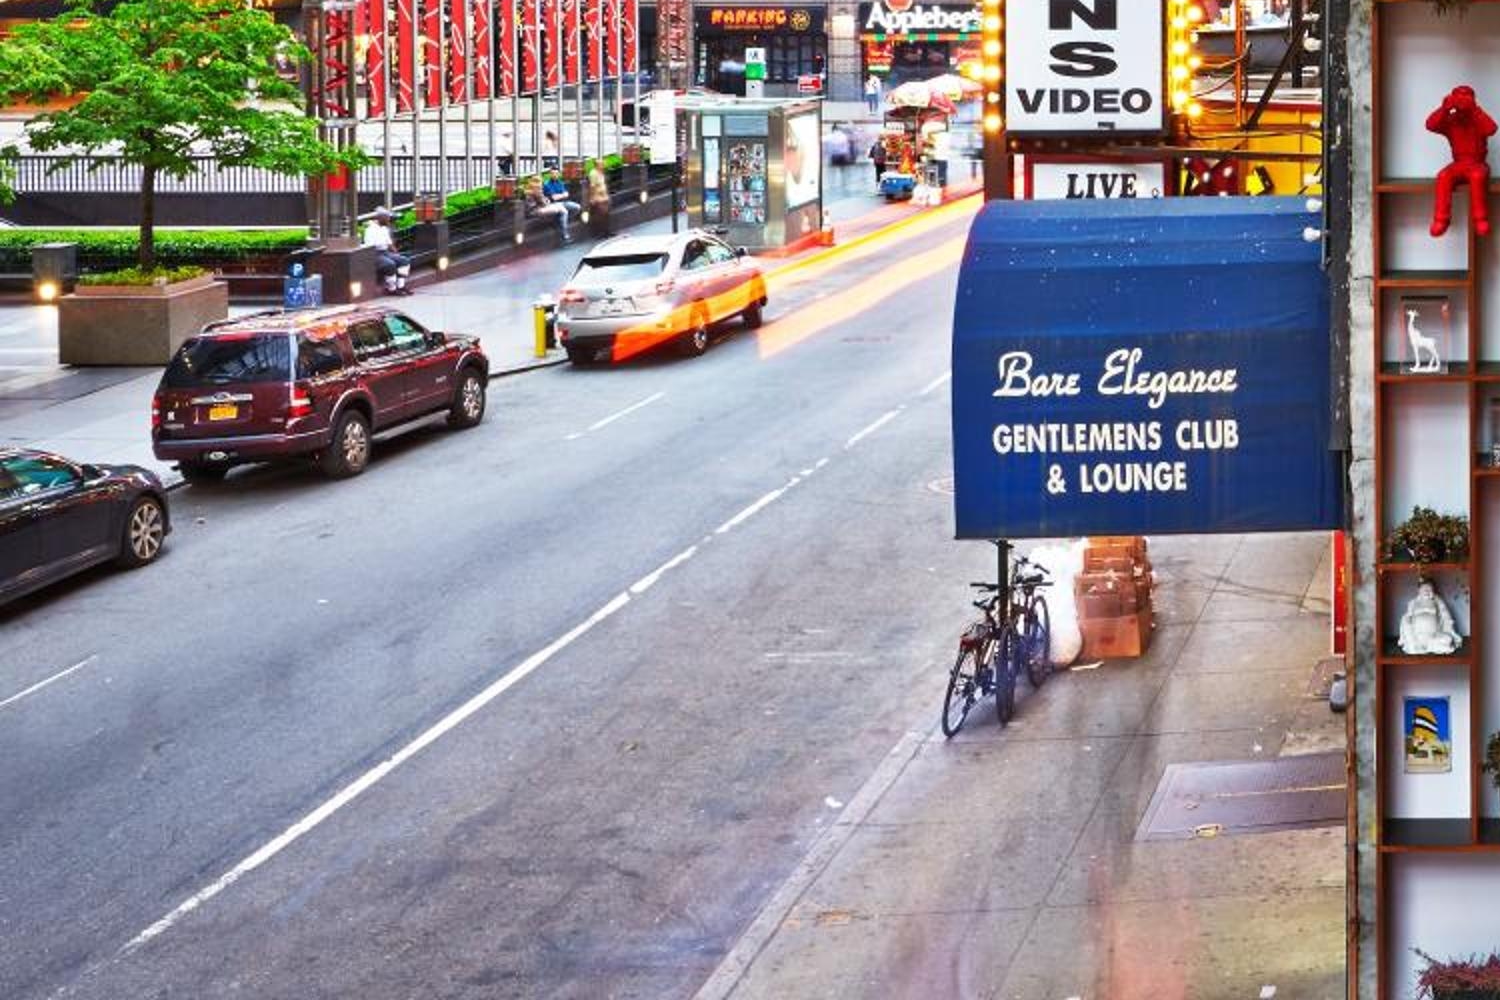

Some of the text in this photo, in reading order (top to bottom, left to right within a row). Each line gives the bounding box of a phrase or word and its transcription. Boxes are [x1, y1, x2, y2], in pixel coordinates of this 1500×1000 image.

[711, 9, 787, 25] PARKING
[1016, 88, 1153, 115] VIDEO
[1066, 173, 1138, 199] LIVE
[992, 347, 1238, 409] Bare Elegance
[992, 418, 1240, 455] GENTLEMENS CLUB
[1047, 461, 1188, 494] & LOUNGE
